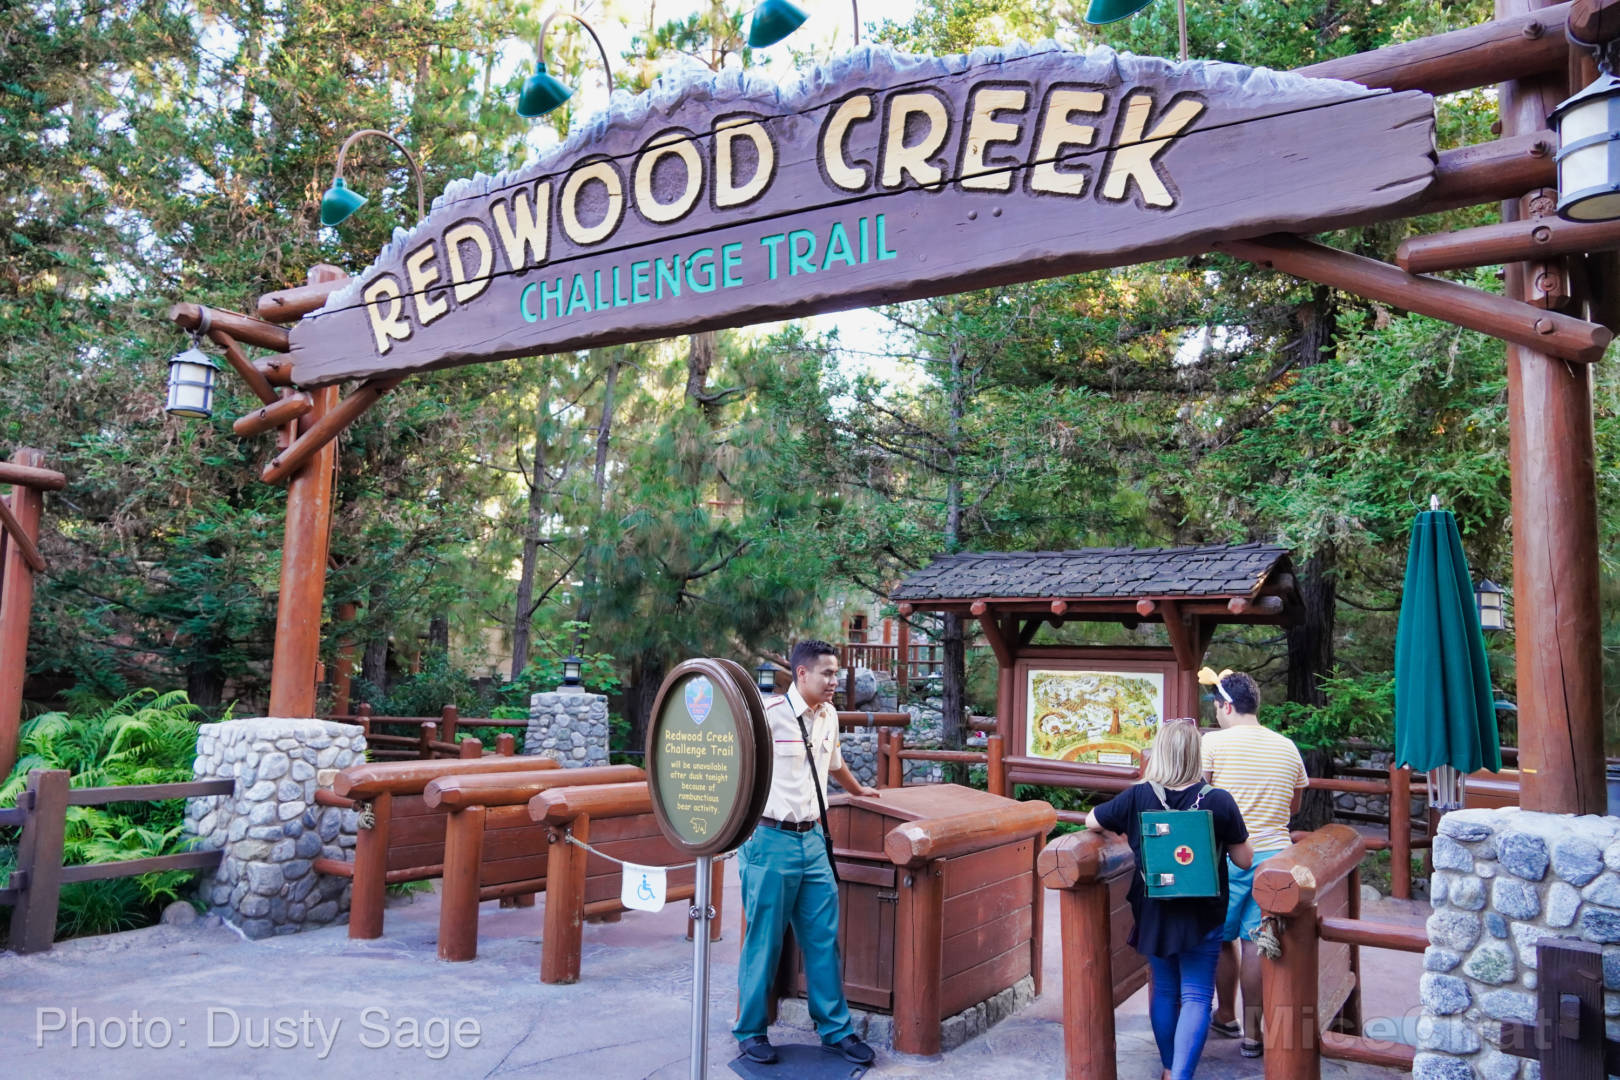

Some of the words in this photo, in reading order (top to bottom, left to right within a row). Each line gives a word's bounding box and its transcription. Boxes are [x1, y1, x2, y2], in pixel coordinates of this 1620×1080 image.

[362, 116, 775, 355] REDWOOD
[822, 89, 1204, 207] CREEK
[520, 242, 745, 324] CHALLENGE
[760, 214, 897, 281] TRAIL
[665, 729, 703, 742] Redwood
[706, 731, 734, 743] Creek
[665, 743, 707, 758] Challenge
[710, 744, 734, 756] Trail
[671, 760, 681, 769] will
[683, 761, 691, 769] be
[693, 762, 728, 771] unavailable
[670, 771, 687, 780] after
[705, 773, 728, 784] tonight
[681, 782, 706, 791] because
[708, 783, 716, 792] of
